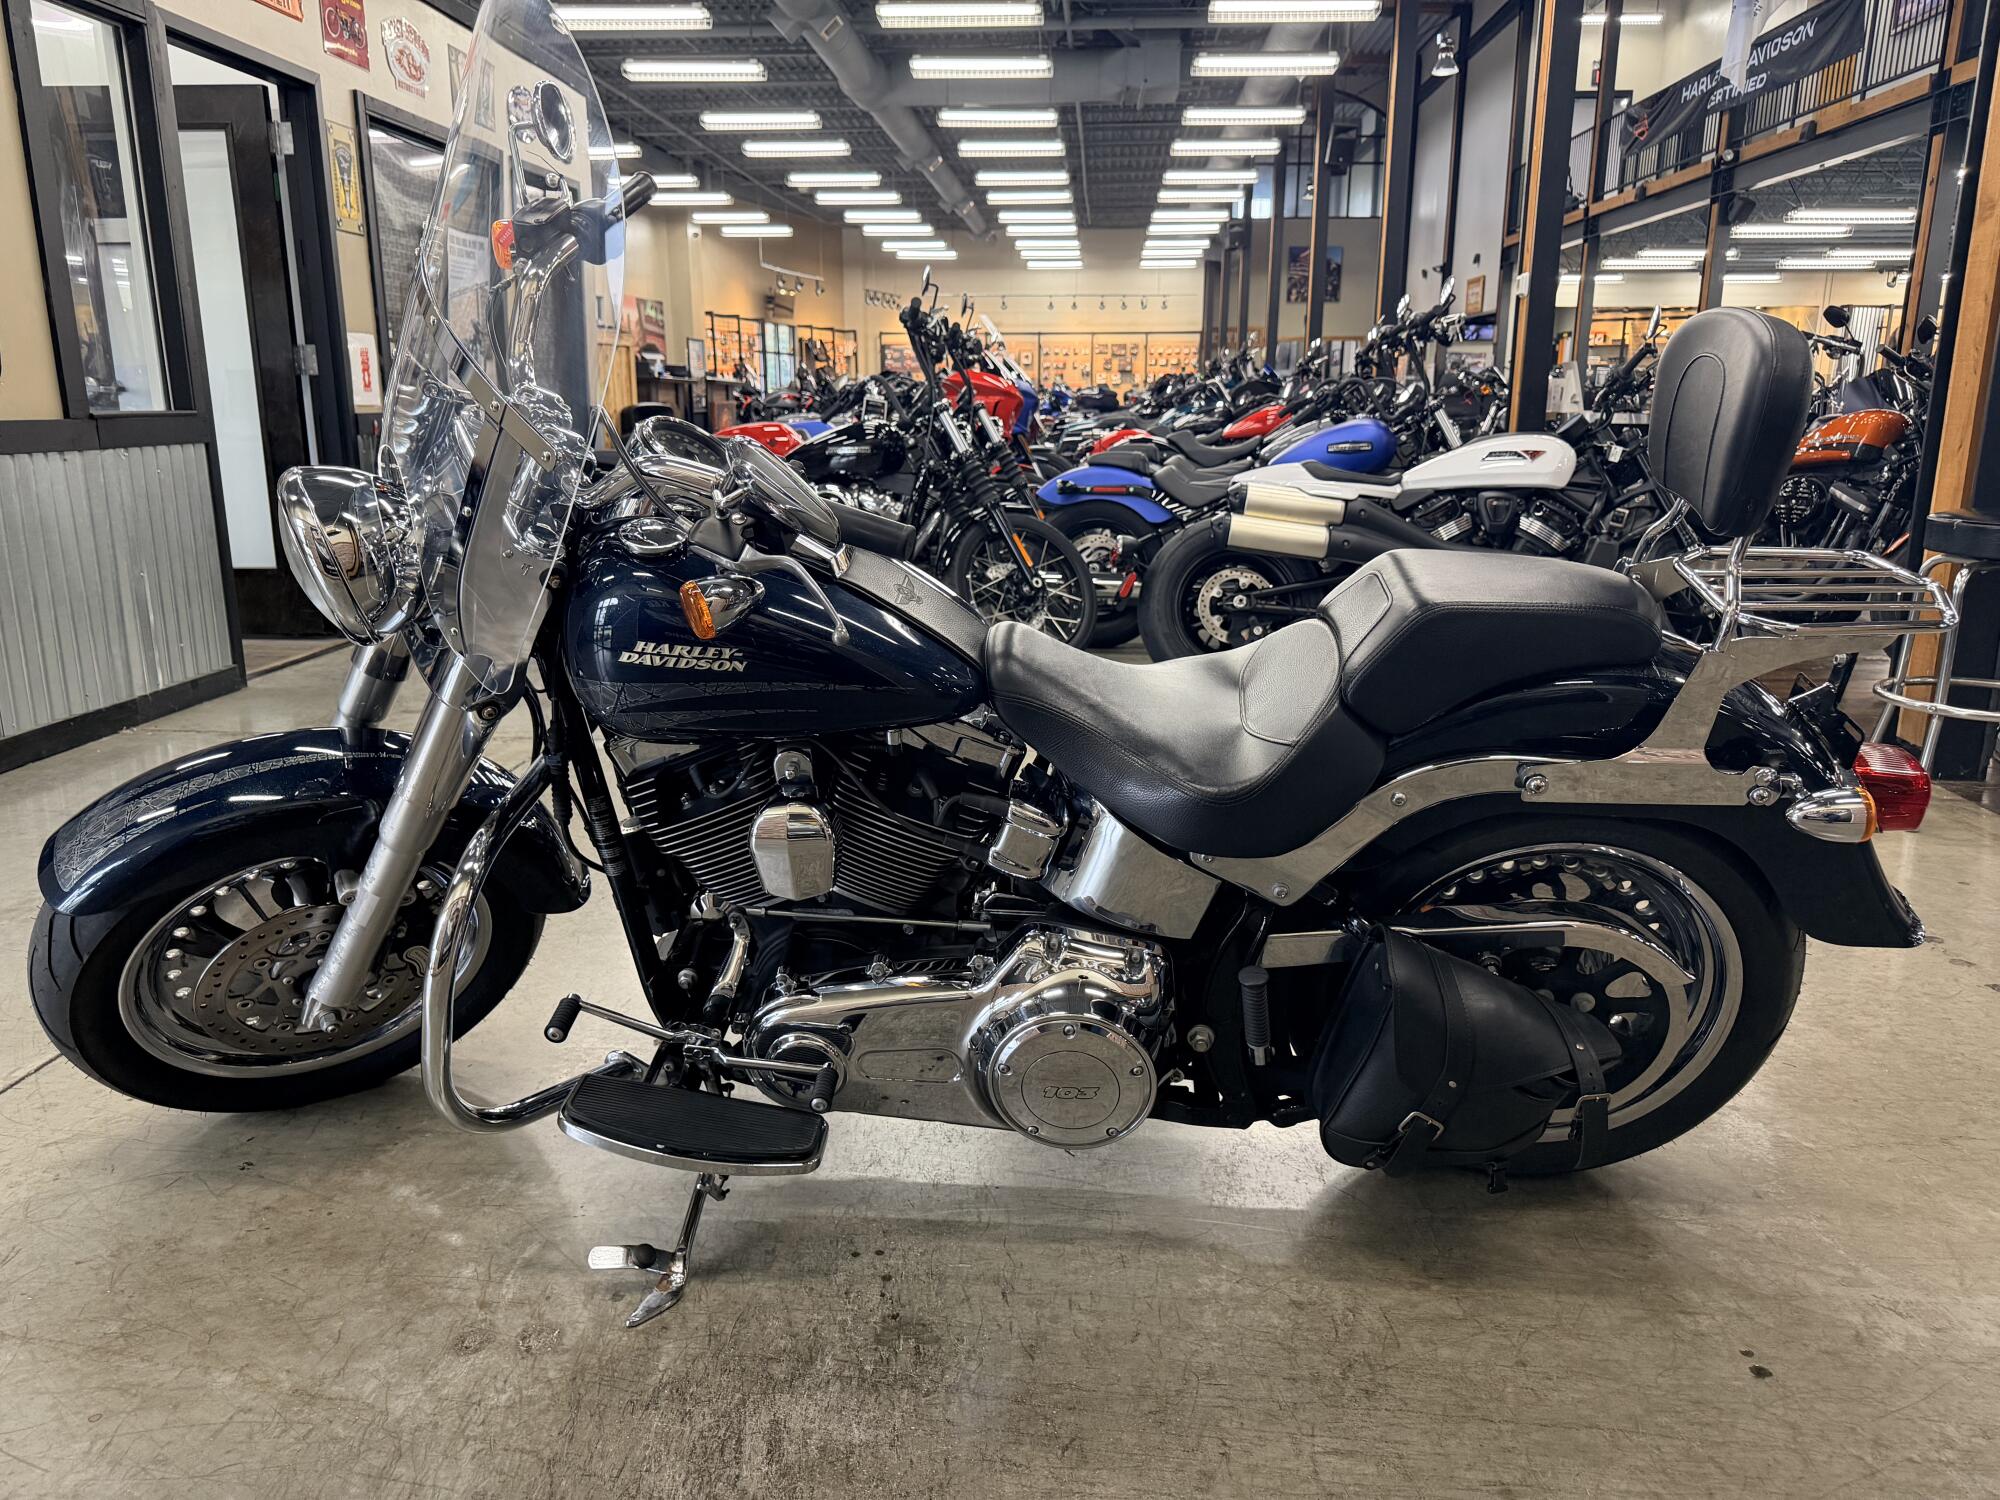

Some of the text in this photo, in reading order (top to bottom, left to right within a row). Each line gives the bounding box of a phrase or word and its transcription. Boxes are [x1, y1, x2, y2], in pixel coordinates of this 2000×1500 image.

[633, 641, 743, 659] HARLEY-
[618, 652, 748, 672] DAVIDSON
[1043, 1086, 1100, 1099] 103
